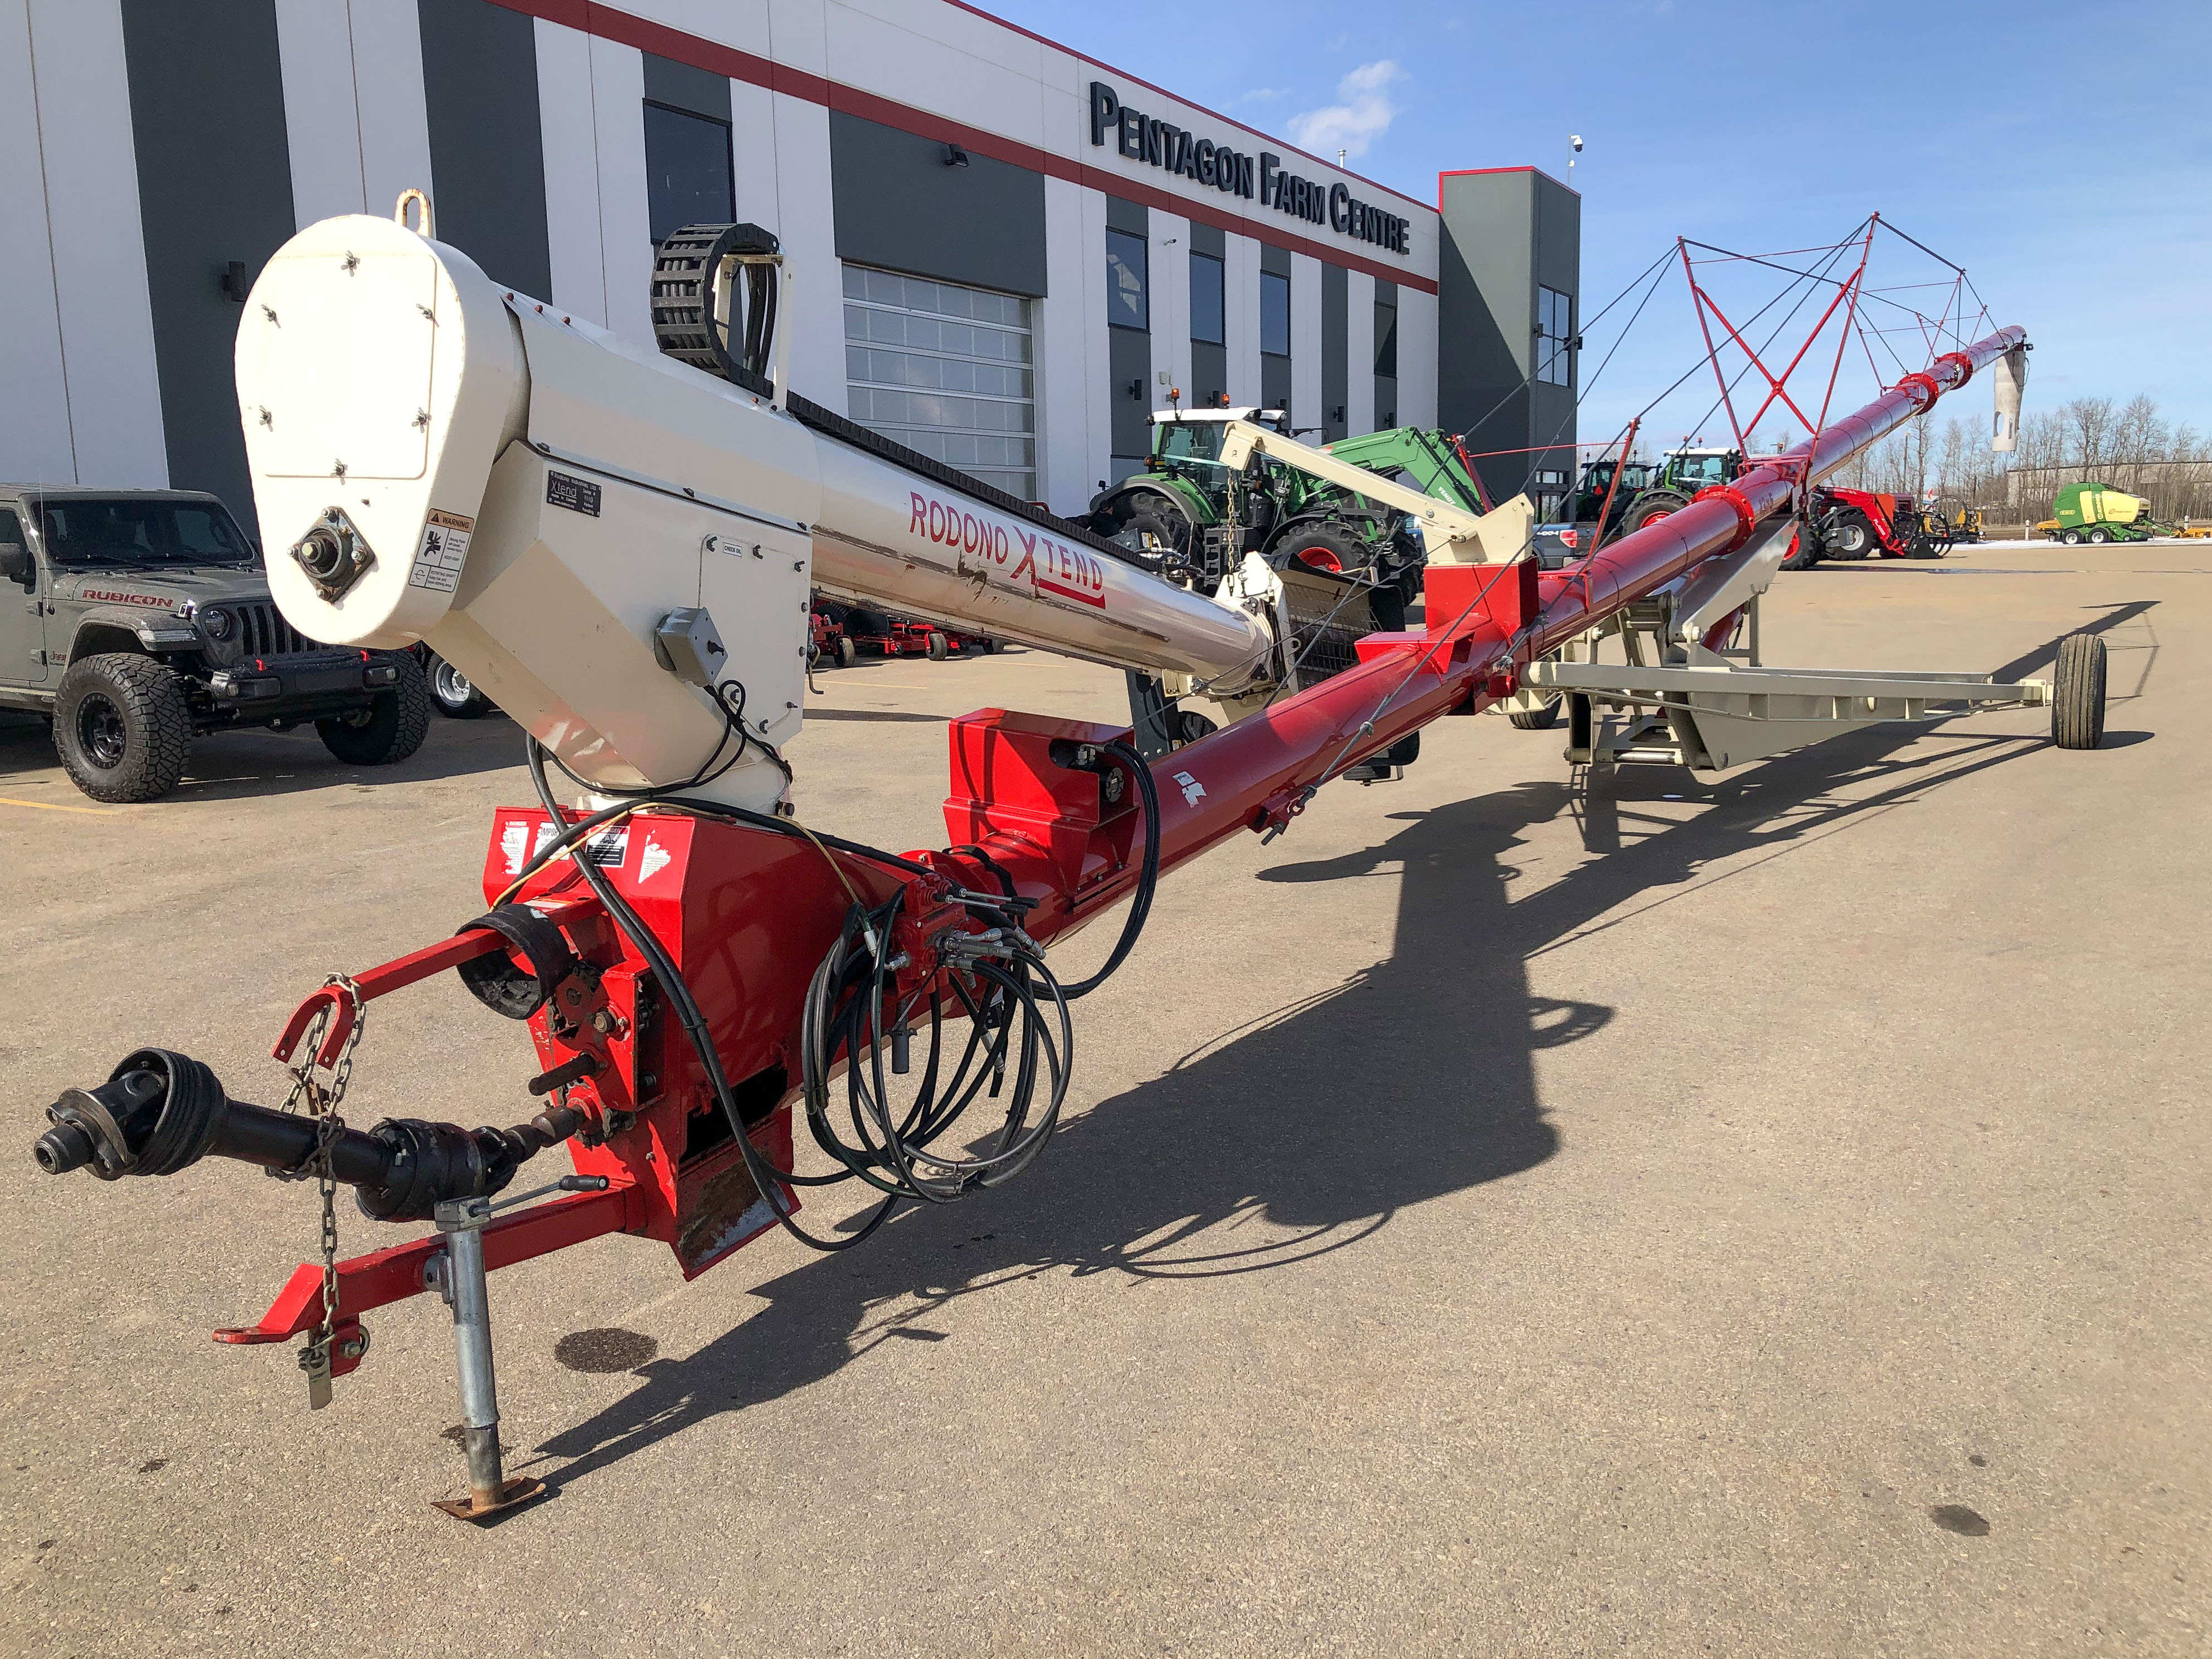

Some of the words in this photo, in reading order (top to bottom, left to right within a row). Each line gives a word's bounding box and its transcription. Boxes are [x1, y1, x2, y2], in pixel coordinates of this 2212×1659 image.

[1090, 81, 1253, 199] PENTAGON
[1261, 152, 1325, 224] FARM
[1330, 182, 1410, 255] CENTRE
[551, 479, 577, 497] Xtend
[1438, 486, 1456, 504] FENDT
[443, 516, 469, 529] WARNING
[910, 491, 1008, 565] RODONO
[1010, 526, 1103, 591] XTEND
[82, 590, 174, 607] RUBICON
[540, 828, 558, 836] IMPOR
